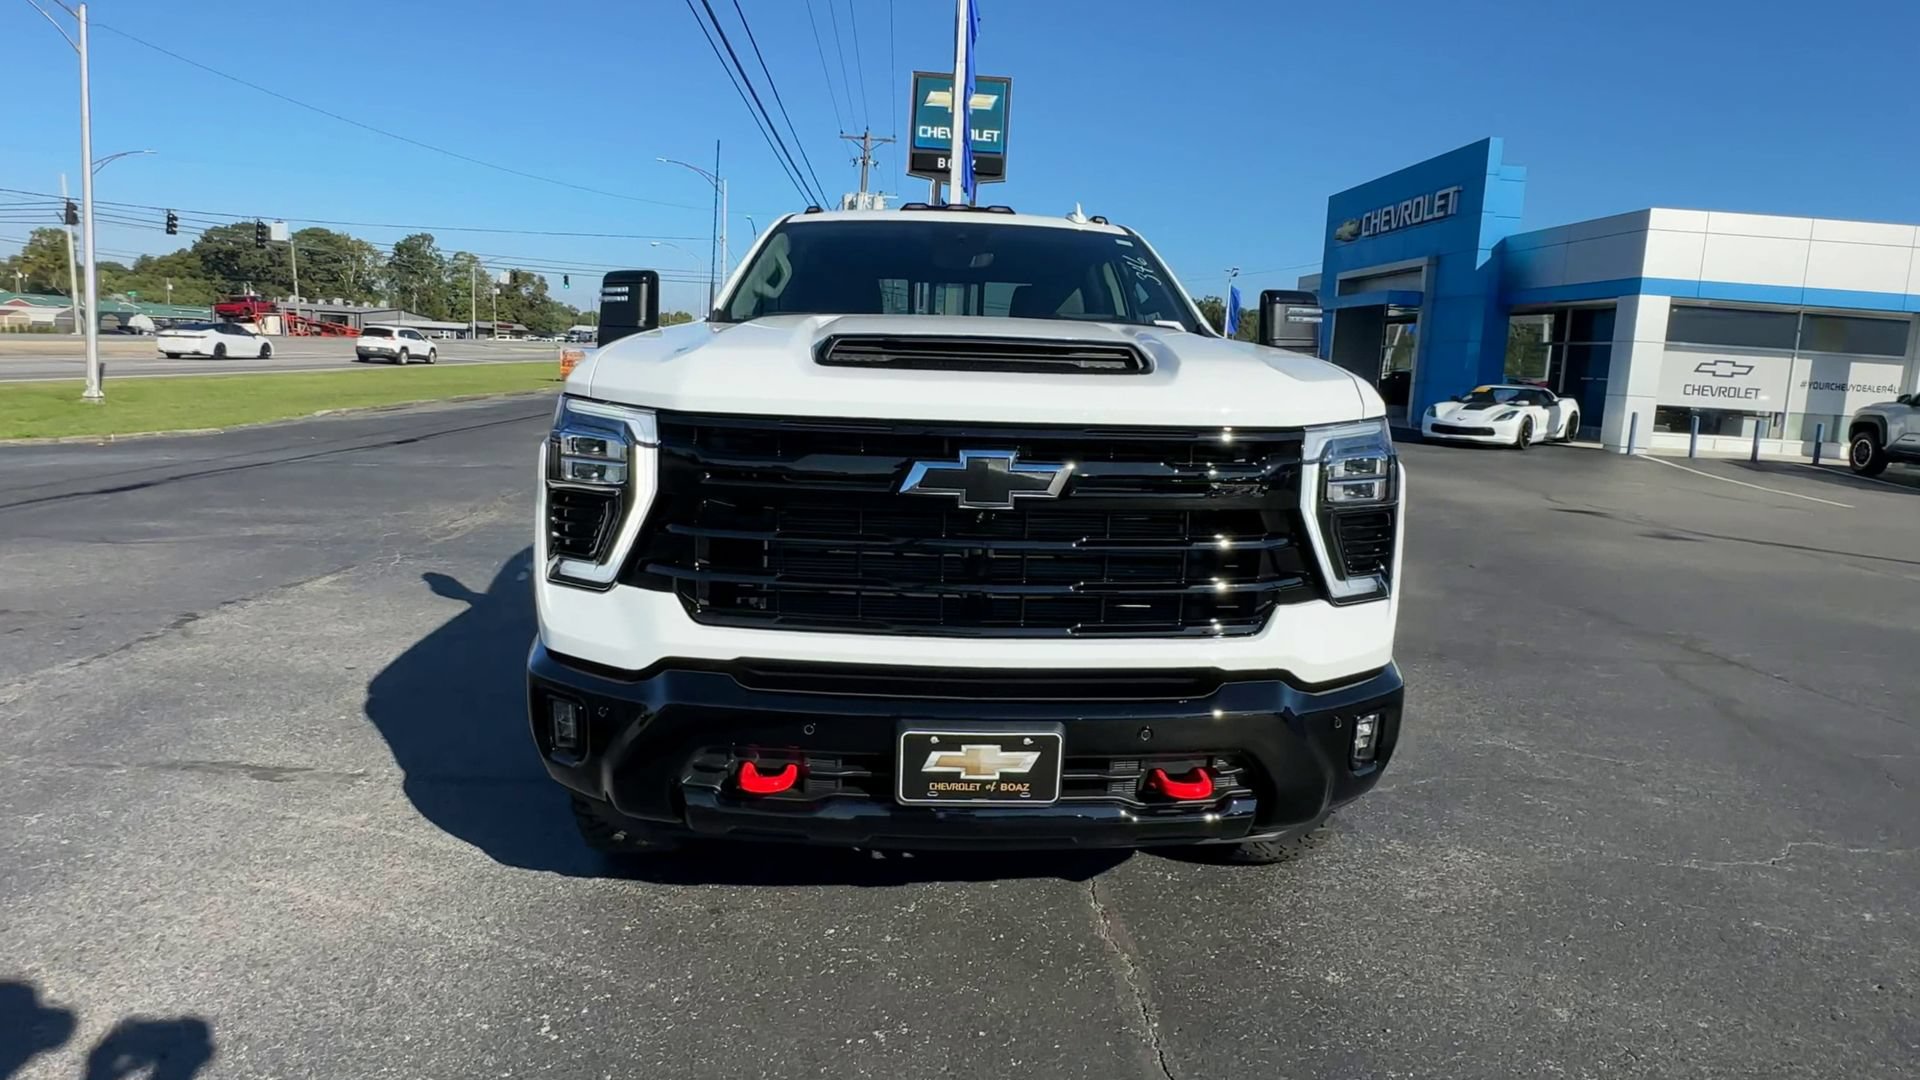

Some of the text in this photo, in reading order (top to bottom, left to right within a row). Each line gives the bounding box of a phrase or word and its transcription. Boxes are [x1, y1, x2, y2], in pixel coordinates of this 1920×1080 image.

[918, 125, 1001, 143] CHEVLET
[937, 157, 977, 171] BZ
[1361, 185, 1462, 237] CHEVROLET
[1683, 383, 1761, 400] CHEVROLET
[929, 781, 1030, 792] CHEVROLET of BOAZ
